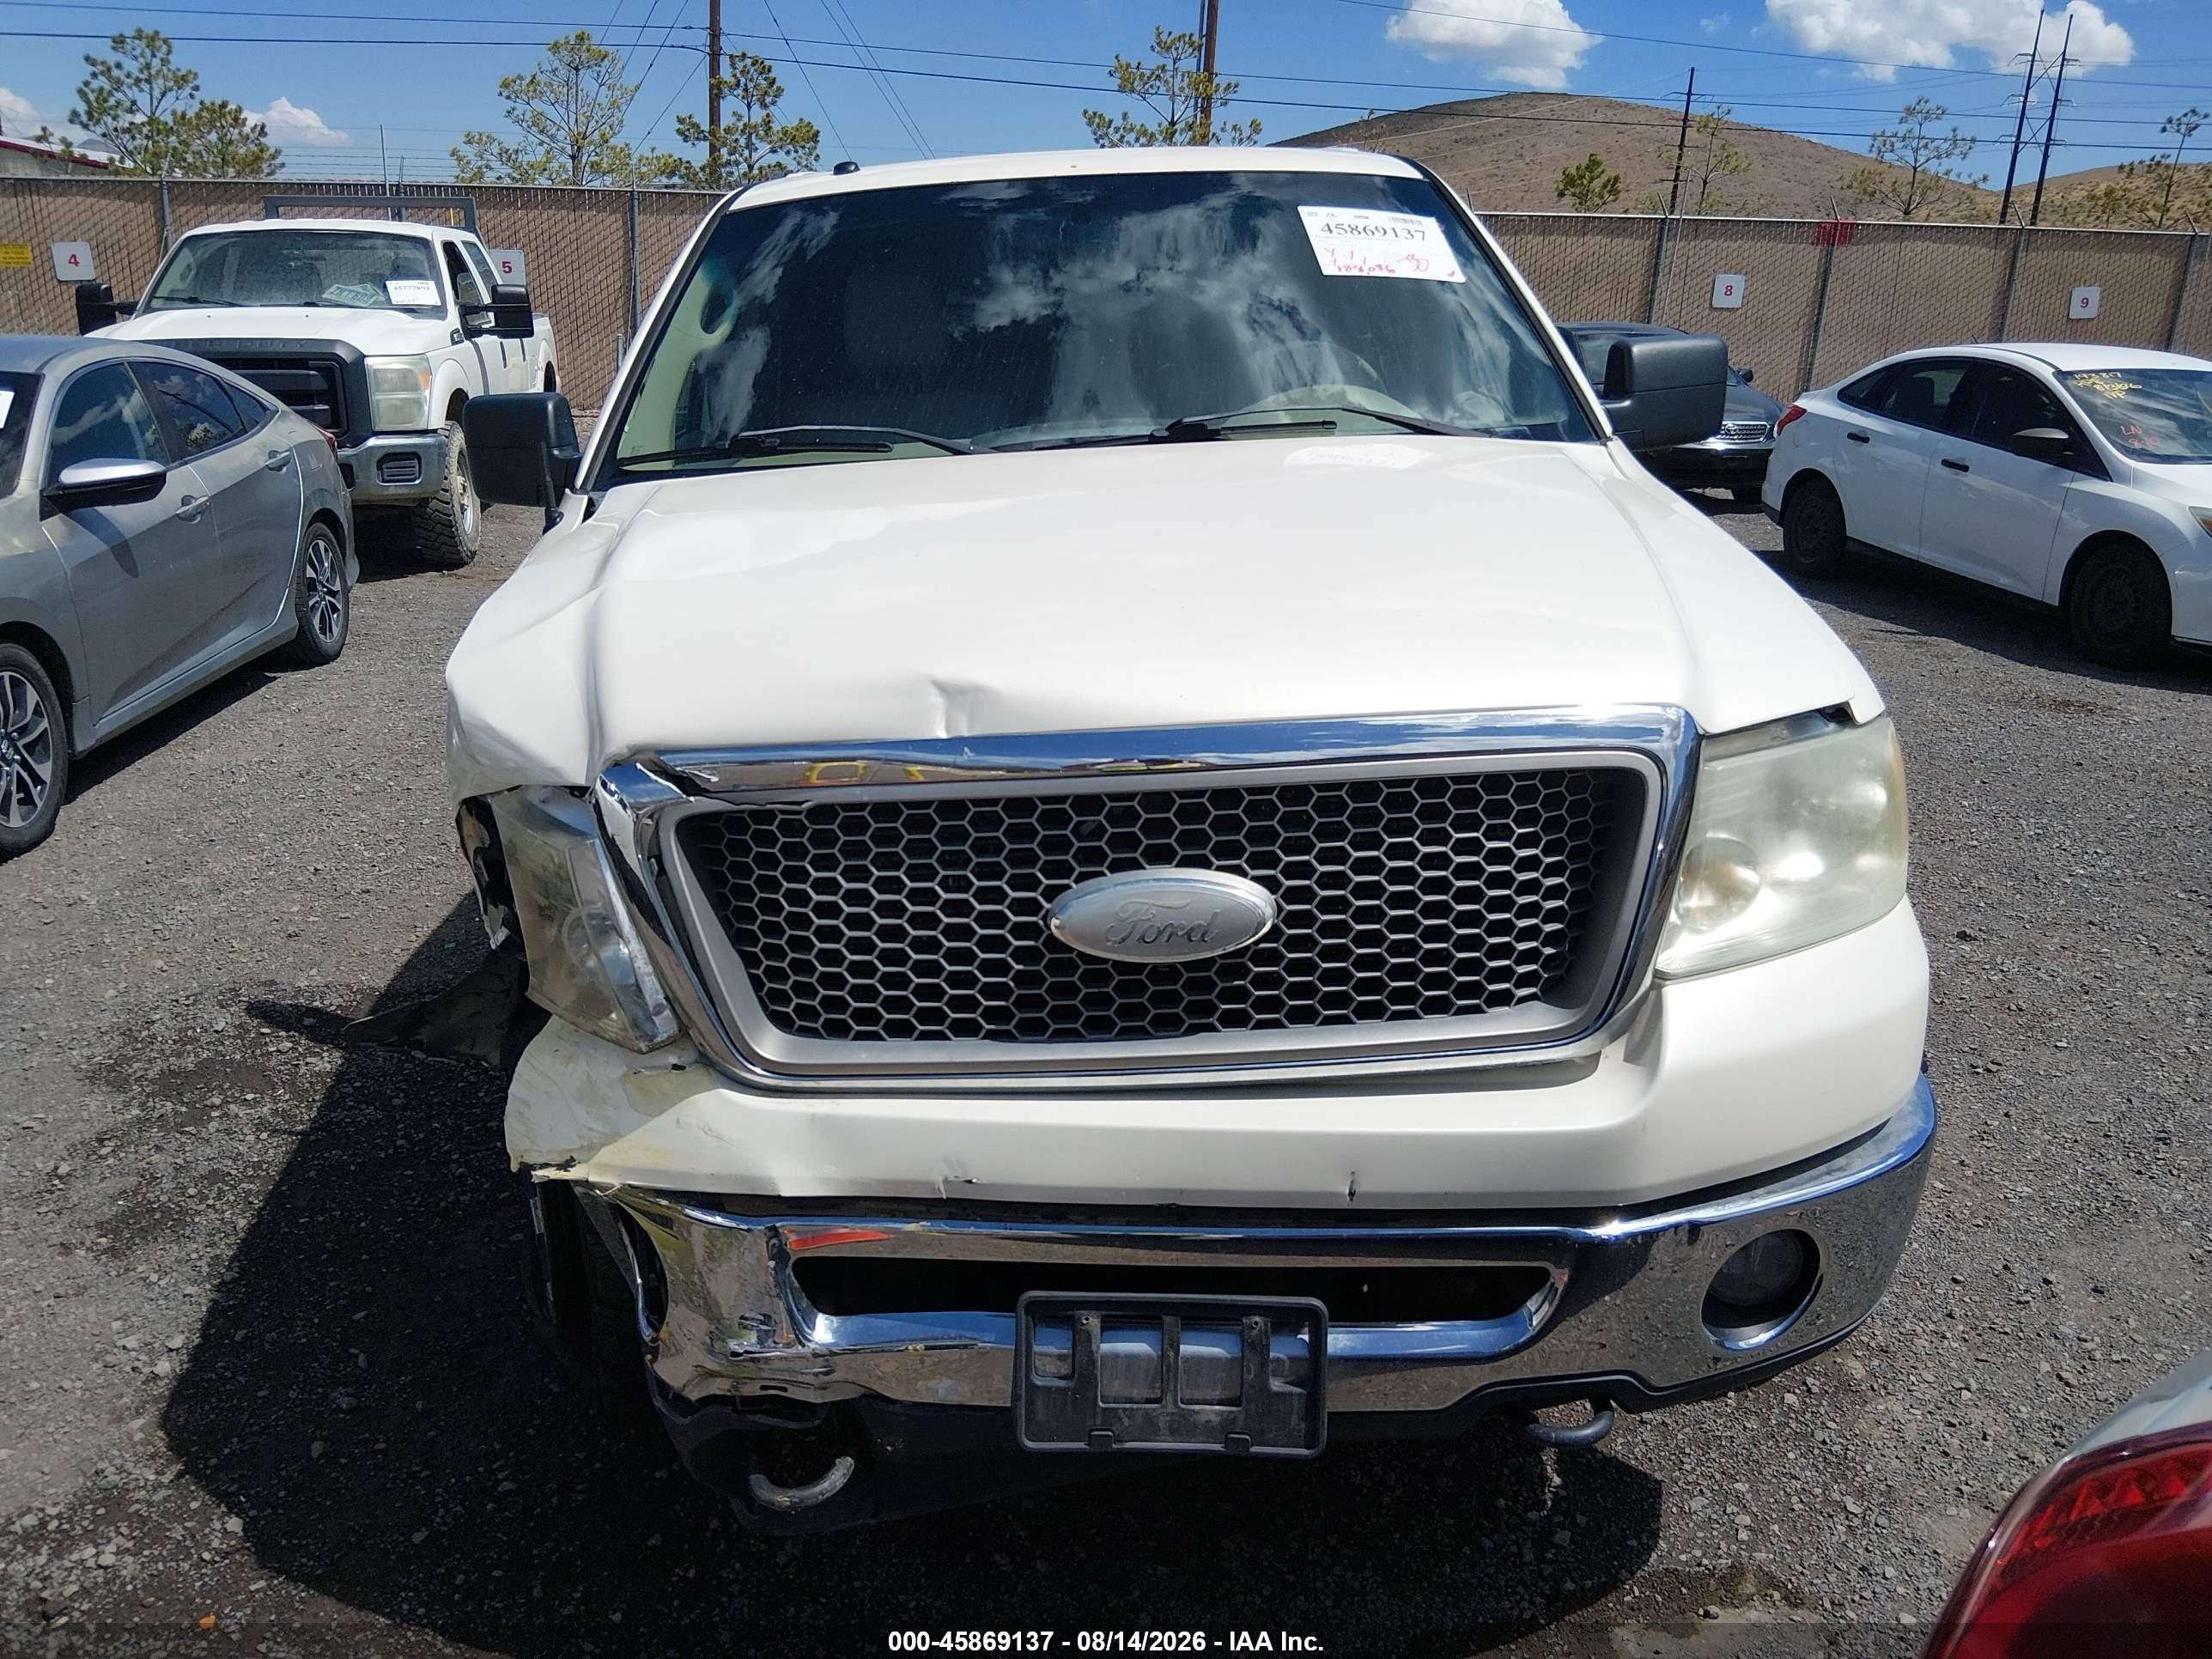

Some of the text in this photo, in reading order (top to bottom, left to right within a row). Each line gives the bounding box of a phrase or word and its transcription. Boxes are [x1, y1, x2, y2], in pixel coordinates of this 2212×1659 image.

[1321, 222, 1425, 241] 45869137
[69, 254, 80, 266] 4
[501, 261, 513, 274] 5
[1724, 285, 1733, 296] 8
[2081, 297, 2089, 308] 9
[1106, 900, 1221, 946] Ford
